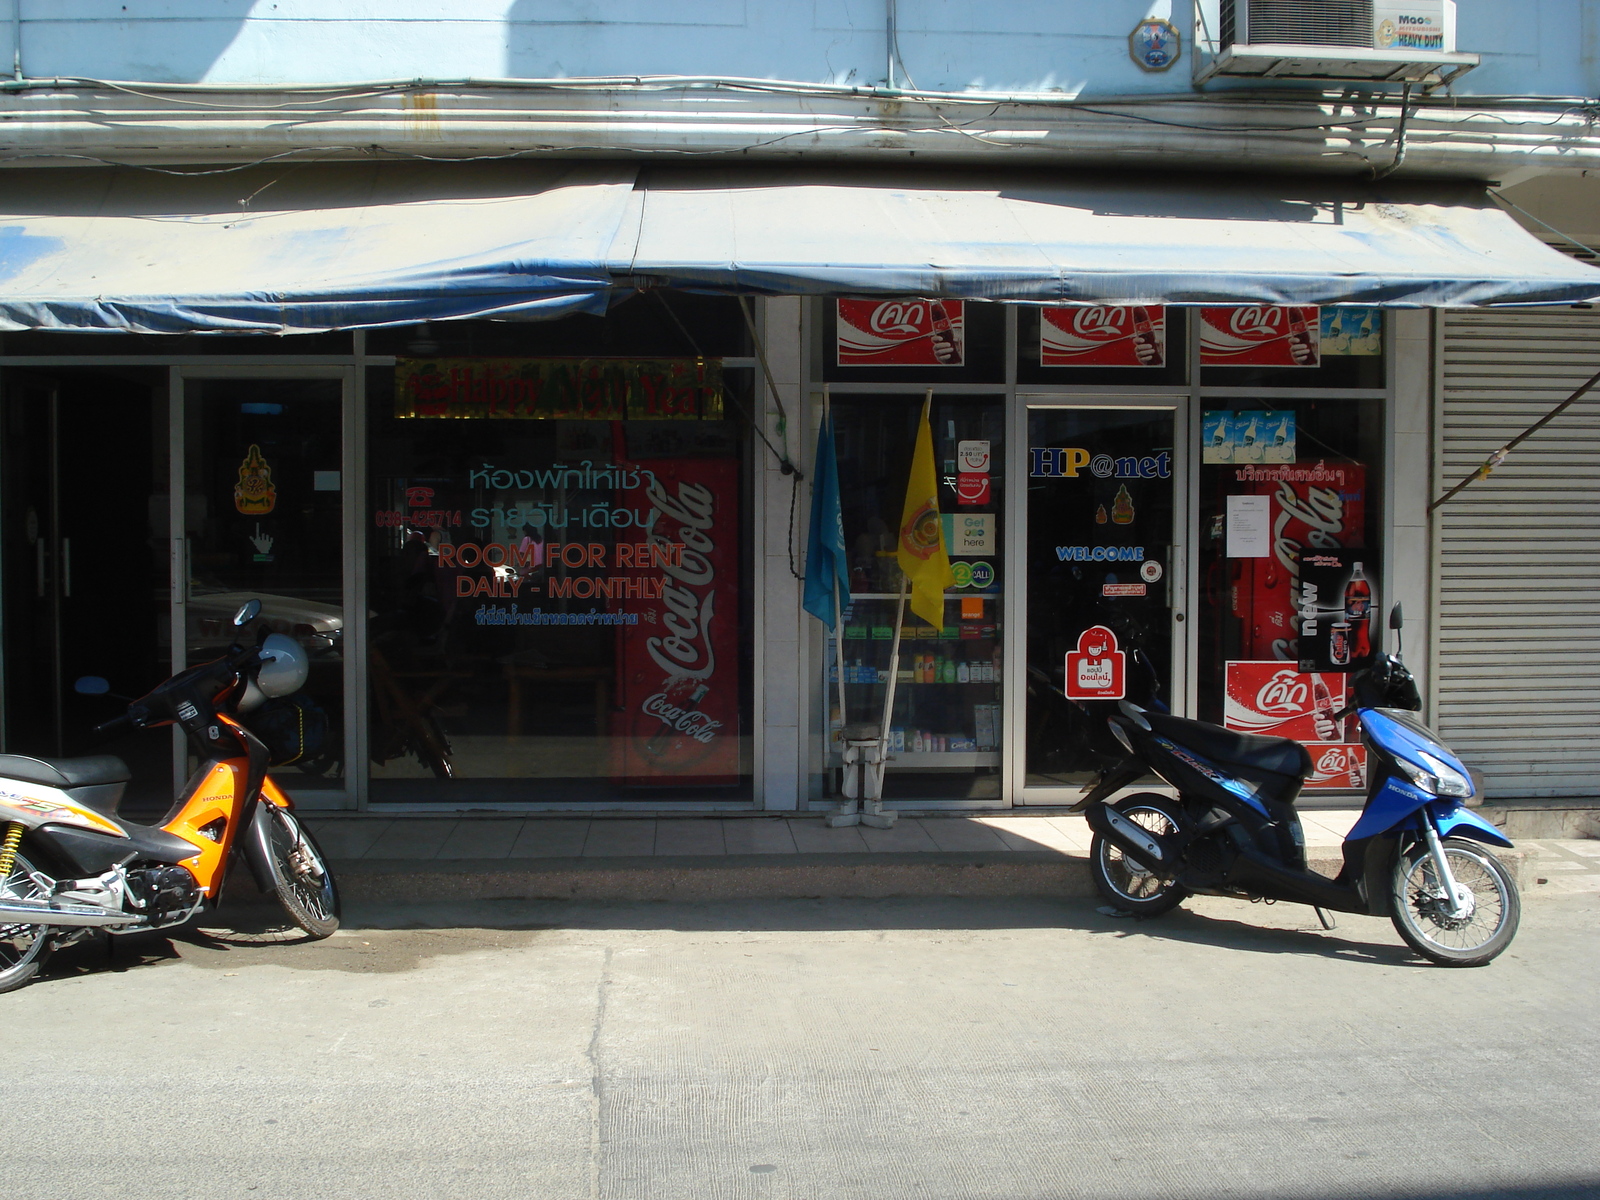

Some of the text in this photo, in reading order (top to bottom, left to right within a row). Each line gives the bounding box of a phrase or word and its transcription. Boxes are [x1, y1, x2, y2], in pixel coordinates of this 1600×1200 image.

[1398, 33, 1444, 48] HEAVY DUTY
[449, 366, 544, 415] Happy
[639, 372, 716, 415] Year
[1030, 446, 1172, 479] HP@net
[469, 460, 656, 490] ห้องพักให้เช่า
[375, 510, 462, 528] 038-425714
[470, 502, 655, 529] รายวัน-เดือน
[964, 517, 985, 528] Get
[963, 537, 985, 547] here
[437, 542, 687, 568] ROOM FOR RENT
[1055, 546, 1145, 562] WELCOME
[456, 576, 525, 598] DAILY
[548, 577, 670, 599] MONTHLY
[1302, 581, 1318, 637] new
[641, 692, 723, 745] Coca-Cola
[201, 793, 235, 803] HONDA
[1387, 783, 1420, 802] HONDA
